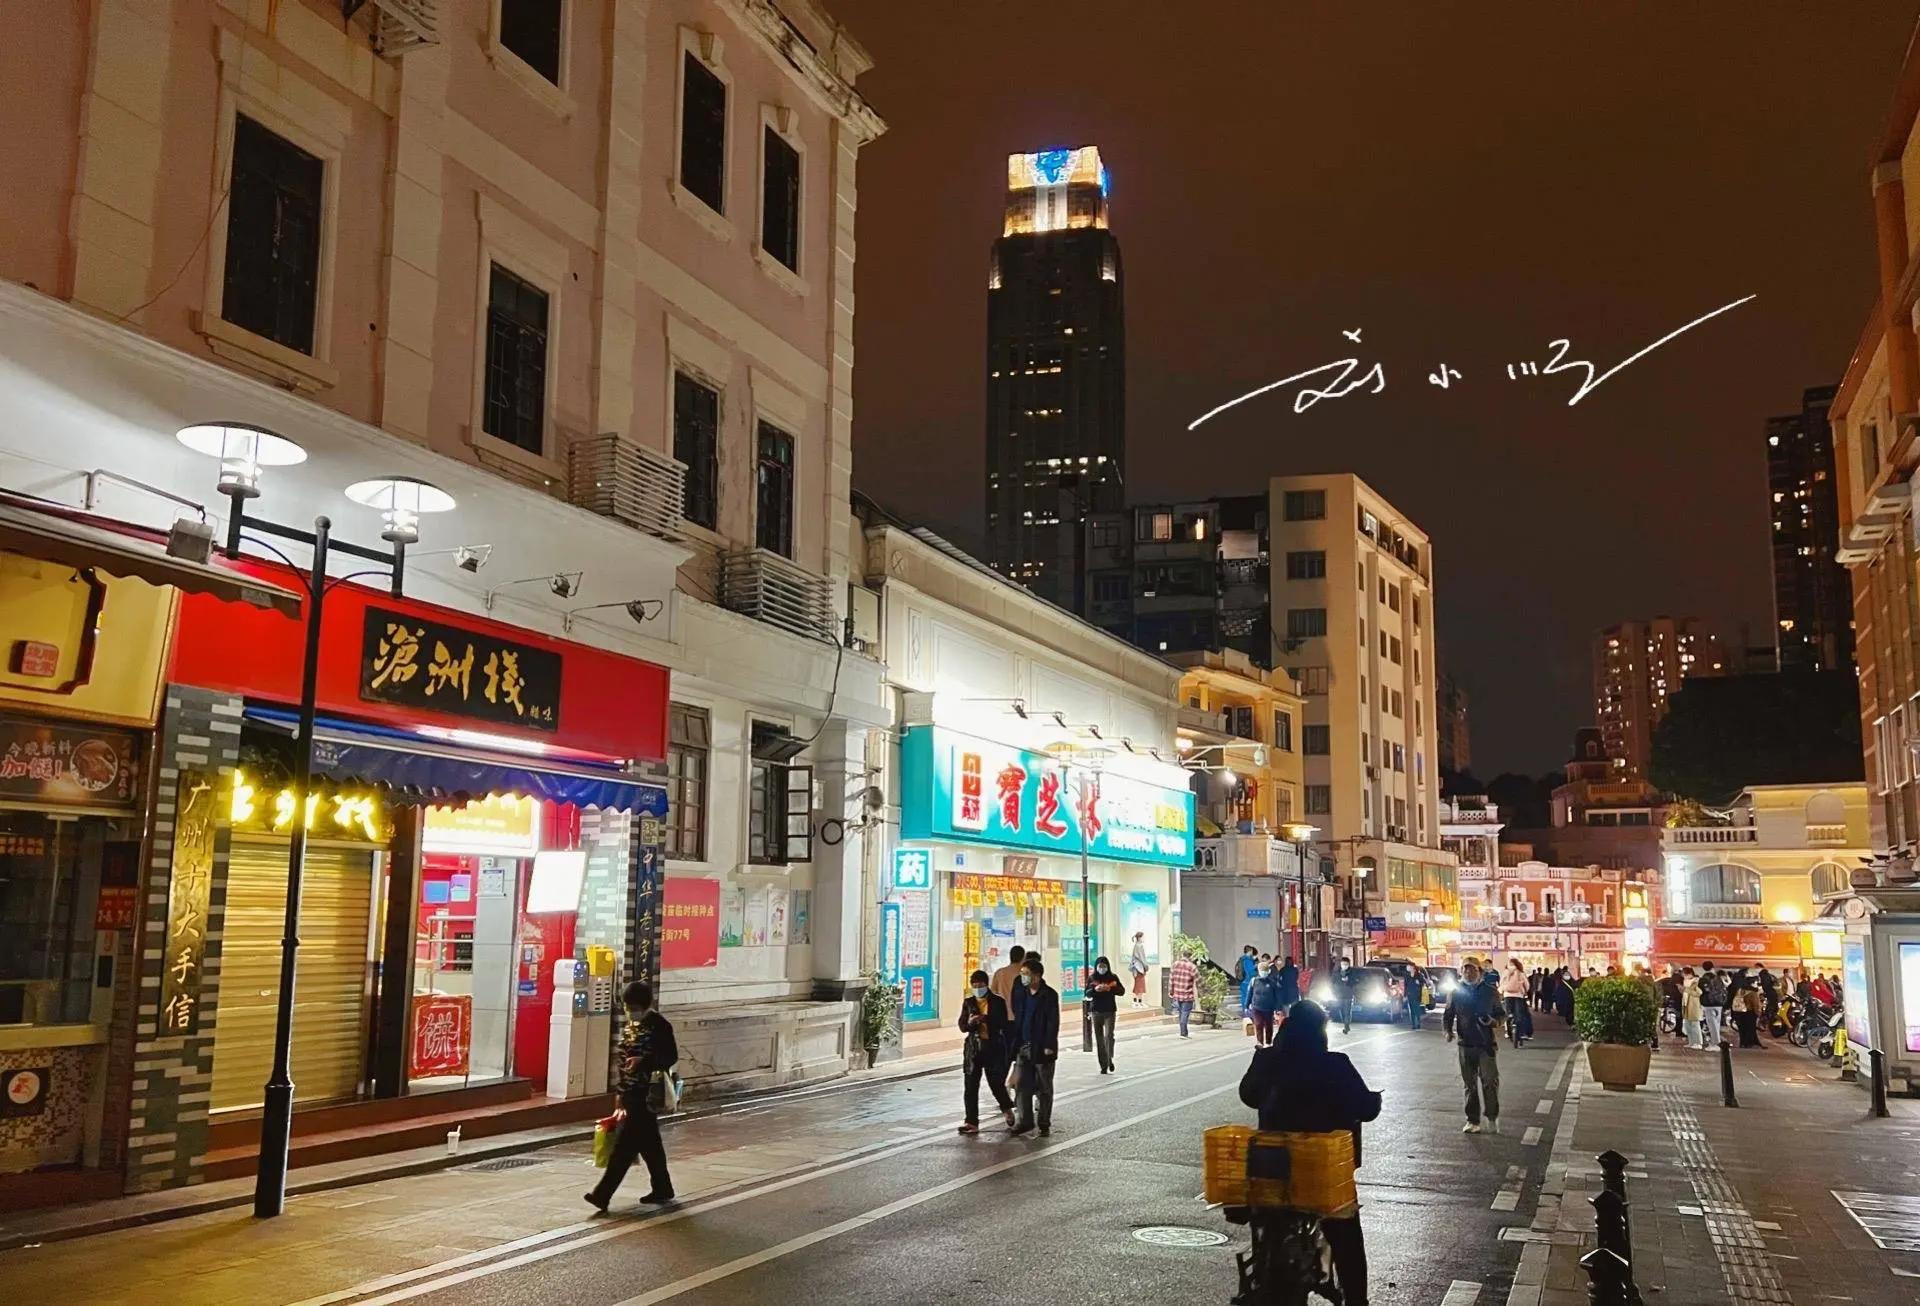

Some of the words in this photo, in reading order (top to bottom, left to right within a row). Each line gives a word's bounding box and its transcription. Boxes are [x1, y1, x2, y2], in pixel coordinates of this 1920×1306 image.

[165, 778, 212, 1029] 广州十大手信
[639, 849, 654, 985] 中华老字号
[899, 851, 925, 885] 药
